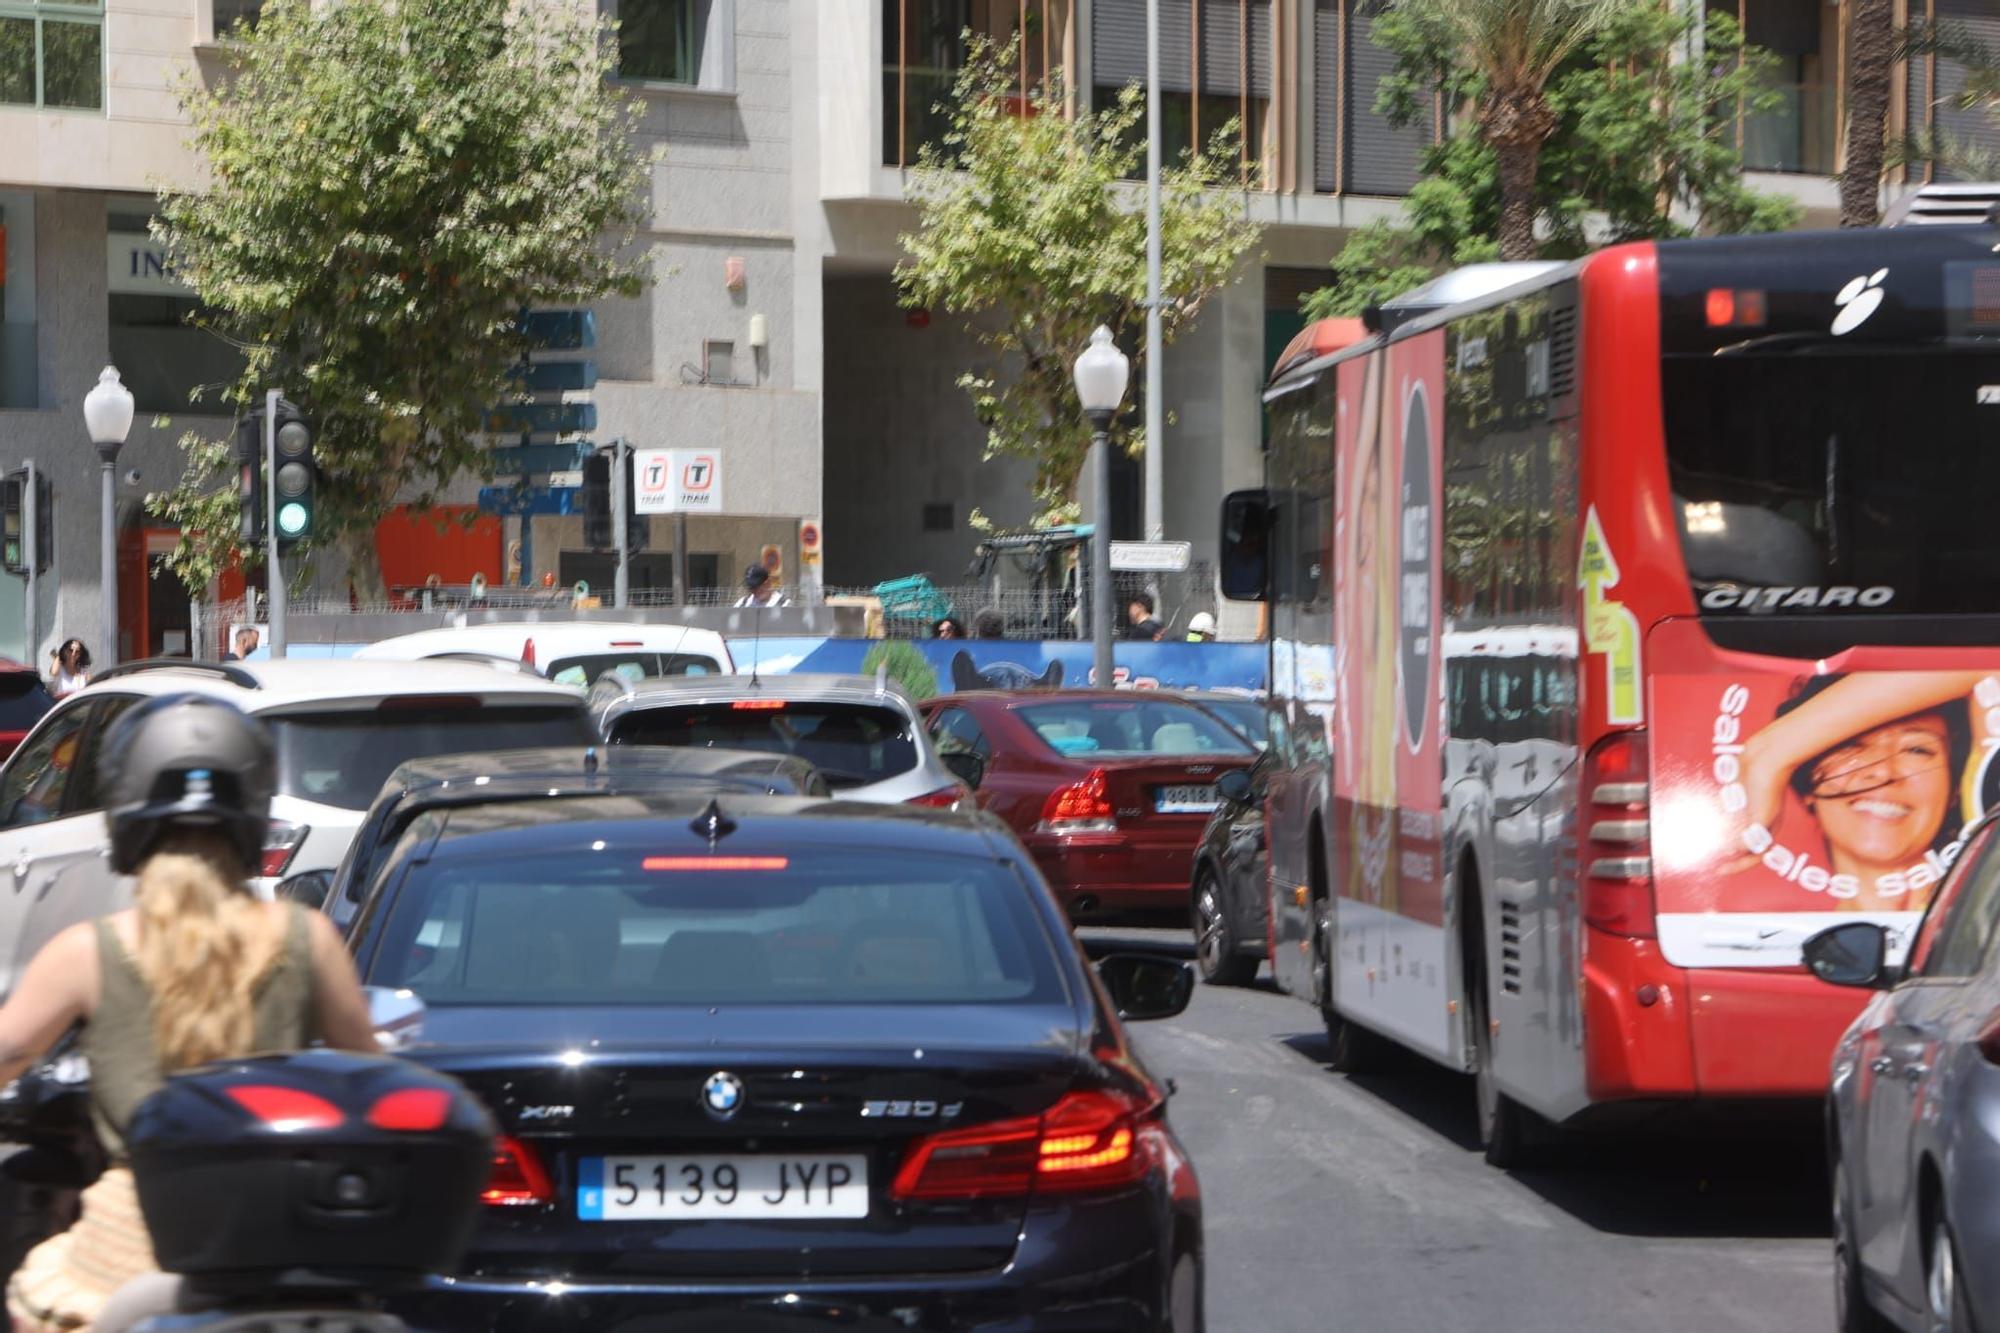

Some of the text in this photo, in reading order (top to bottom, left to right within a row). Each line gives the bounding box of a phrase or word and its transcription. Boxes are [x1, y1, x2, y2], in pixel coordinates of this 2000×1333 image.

[691, 465, 707, 483] T
[1702, 586, 1895, 609] CITARO
[1712, 683, 1749, 813] sales
[1742, 823, 1859, 899] sales
[614, 1163, 739, 1206] 5139
[763, 1162, 852, 1205] JYP
